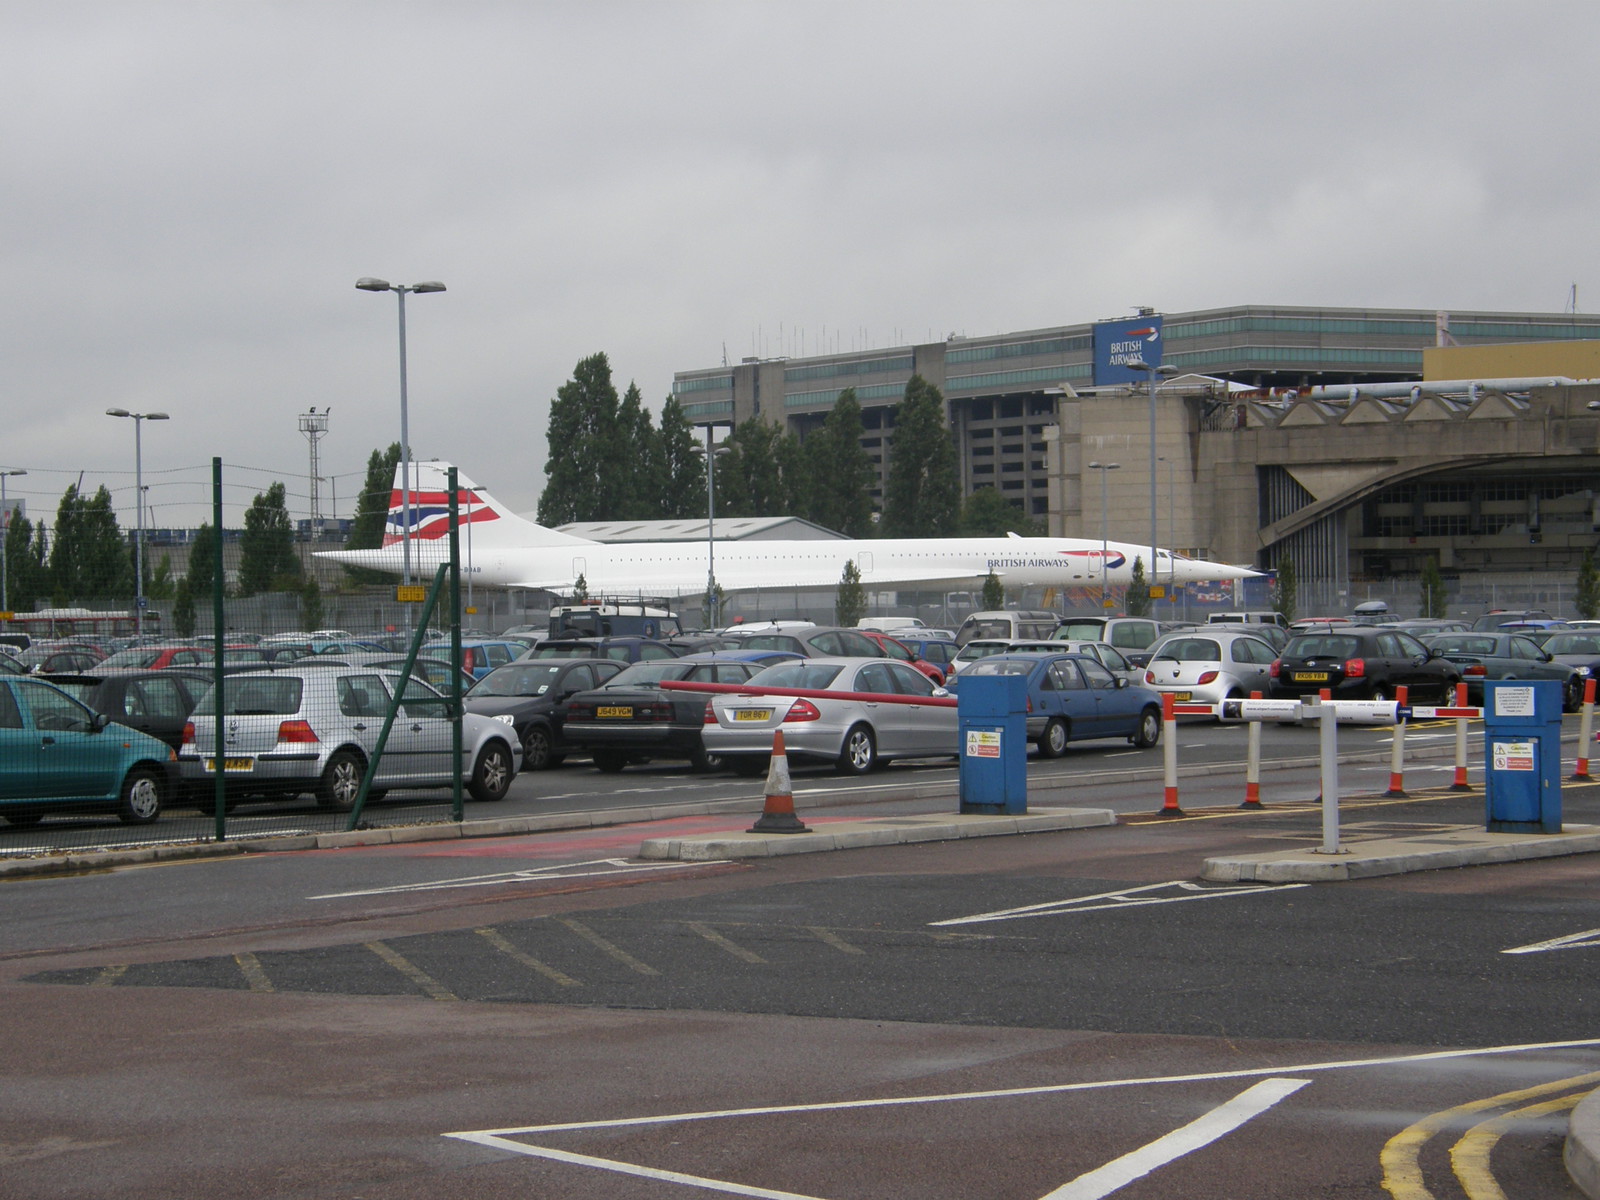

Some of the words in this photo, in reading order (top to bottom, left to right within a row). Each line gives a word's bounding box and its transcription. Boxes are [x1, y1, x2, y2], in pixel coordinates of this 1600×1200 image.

[1111, 340, 1142, 354] BRITISH
[1109, 352, 1143, 366] AIRWAYS
[987, 559, 1026, 567] BRITISH
[1028, 559, 1069, 567] AIRWAYS
